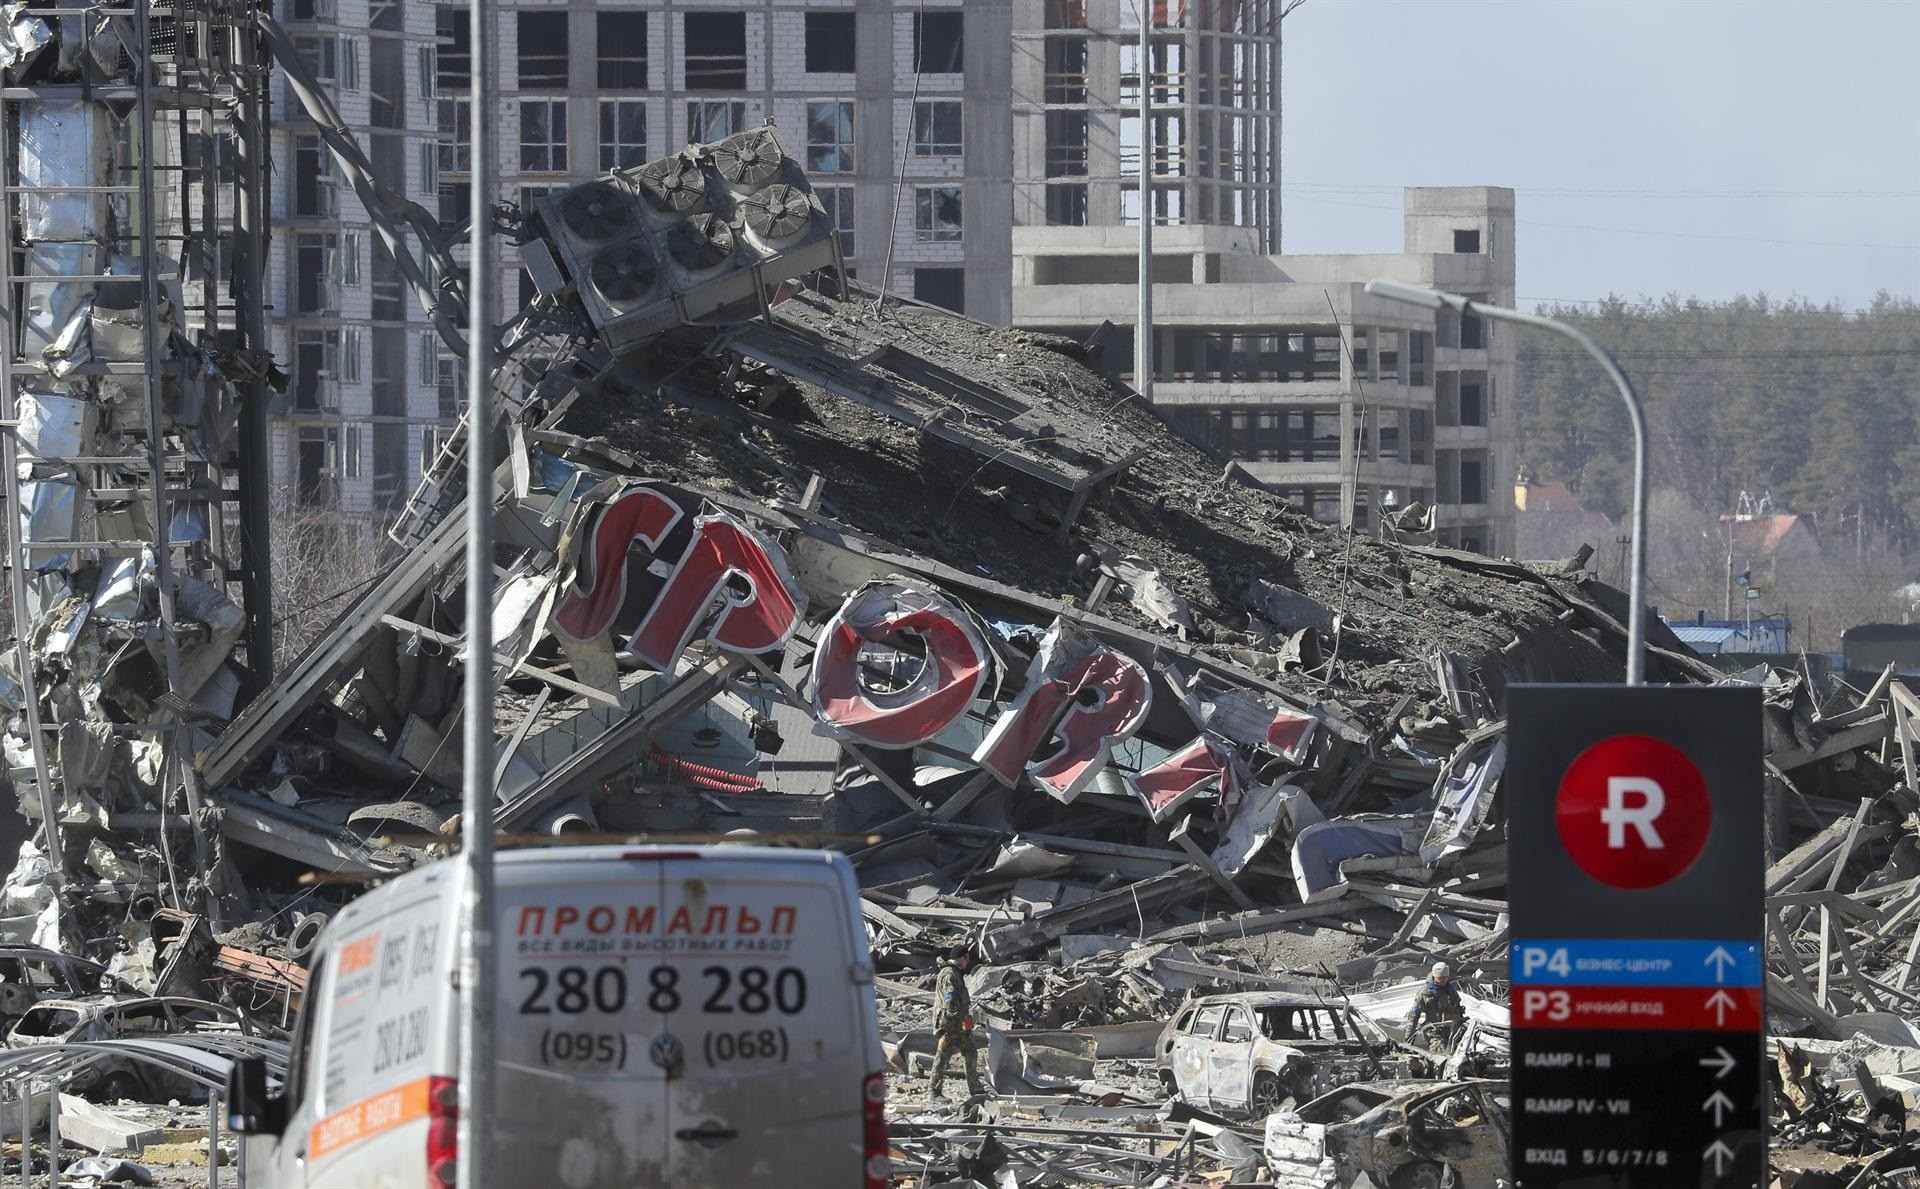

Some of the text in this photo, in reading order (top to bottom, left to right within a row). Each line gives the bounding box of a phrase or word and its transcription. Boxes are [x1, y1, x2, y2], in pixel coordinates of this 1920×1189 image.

[516, 904, 798, 936] ПРОМАЛЬП
[517, 937, 795, 953] ВСЕ ВИДЫ ВЫСОТНЫХ РАБОТ
[1523, 947, 1572, 978] P4
[518, 965, 808, 1016] 280 8 280
[1523, 990, 1572, 1021] P3
[1630, 1001, 1664, 1016] ВХІД
[541, 1026, 789, 1069] (095) (068)
[1524, 1052, 1574, 1067] RAMP
[1524, 1098, 1574, 1113] RAMP
[1525, 1149, 1568, 1165] ВХІД
